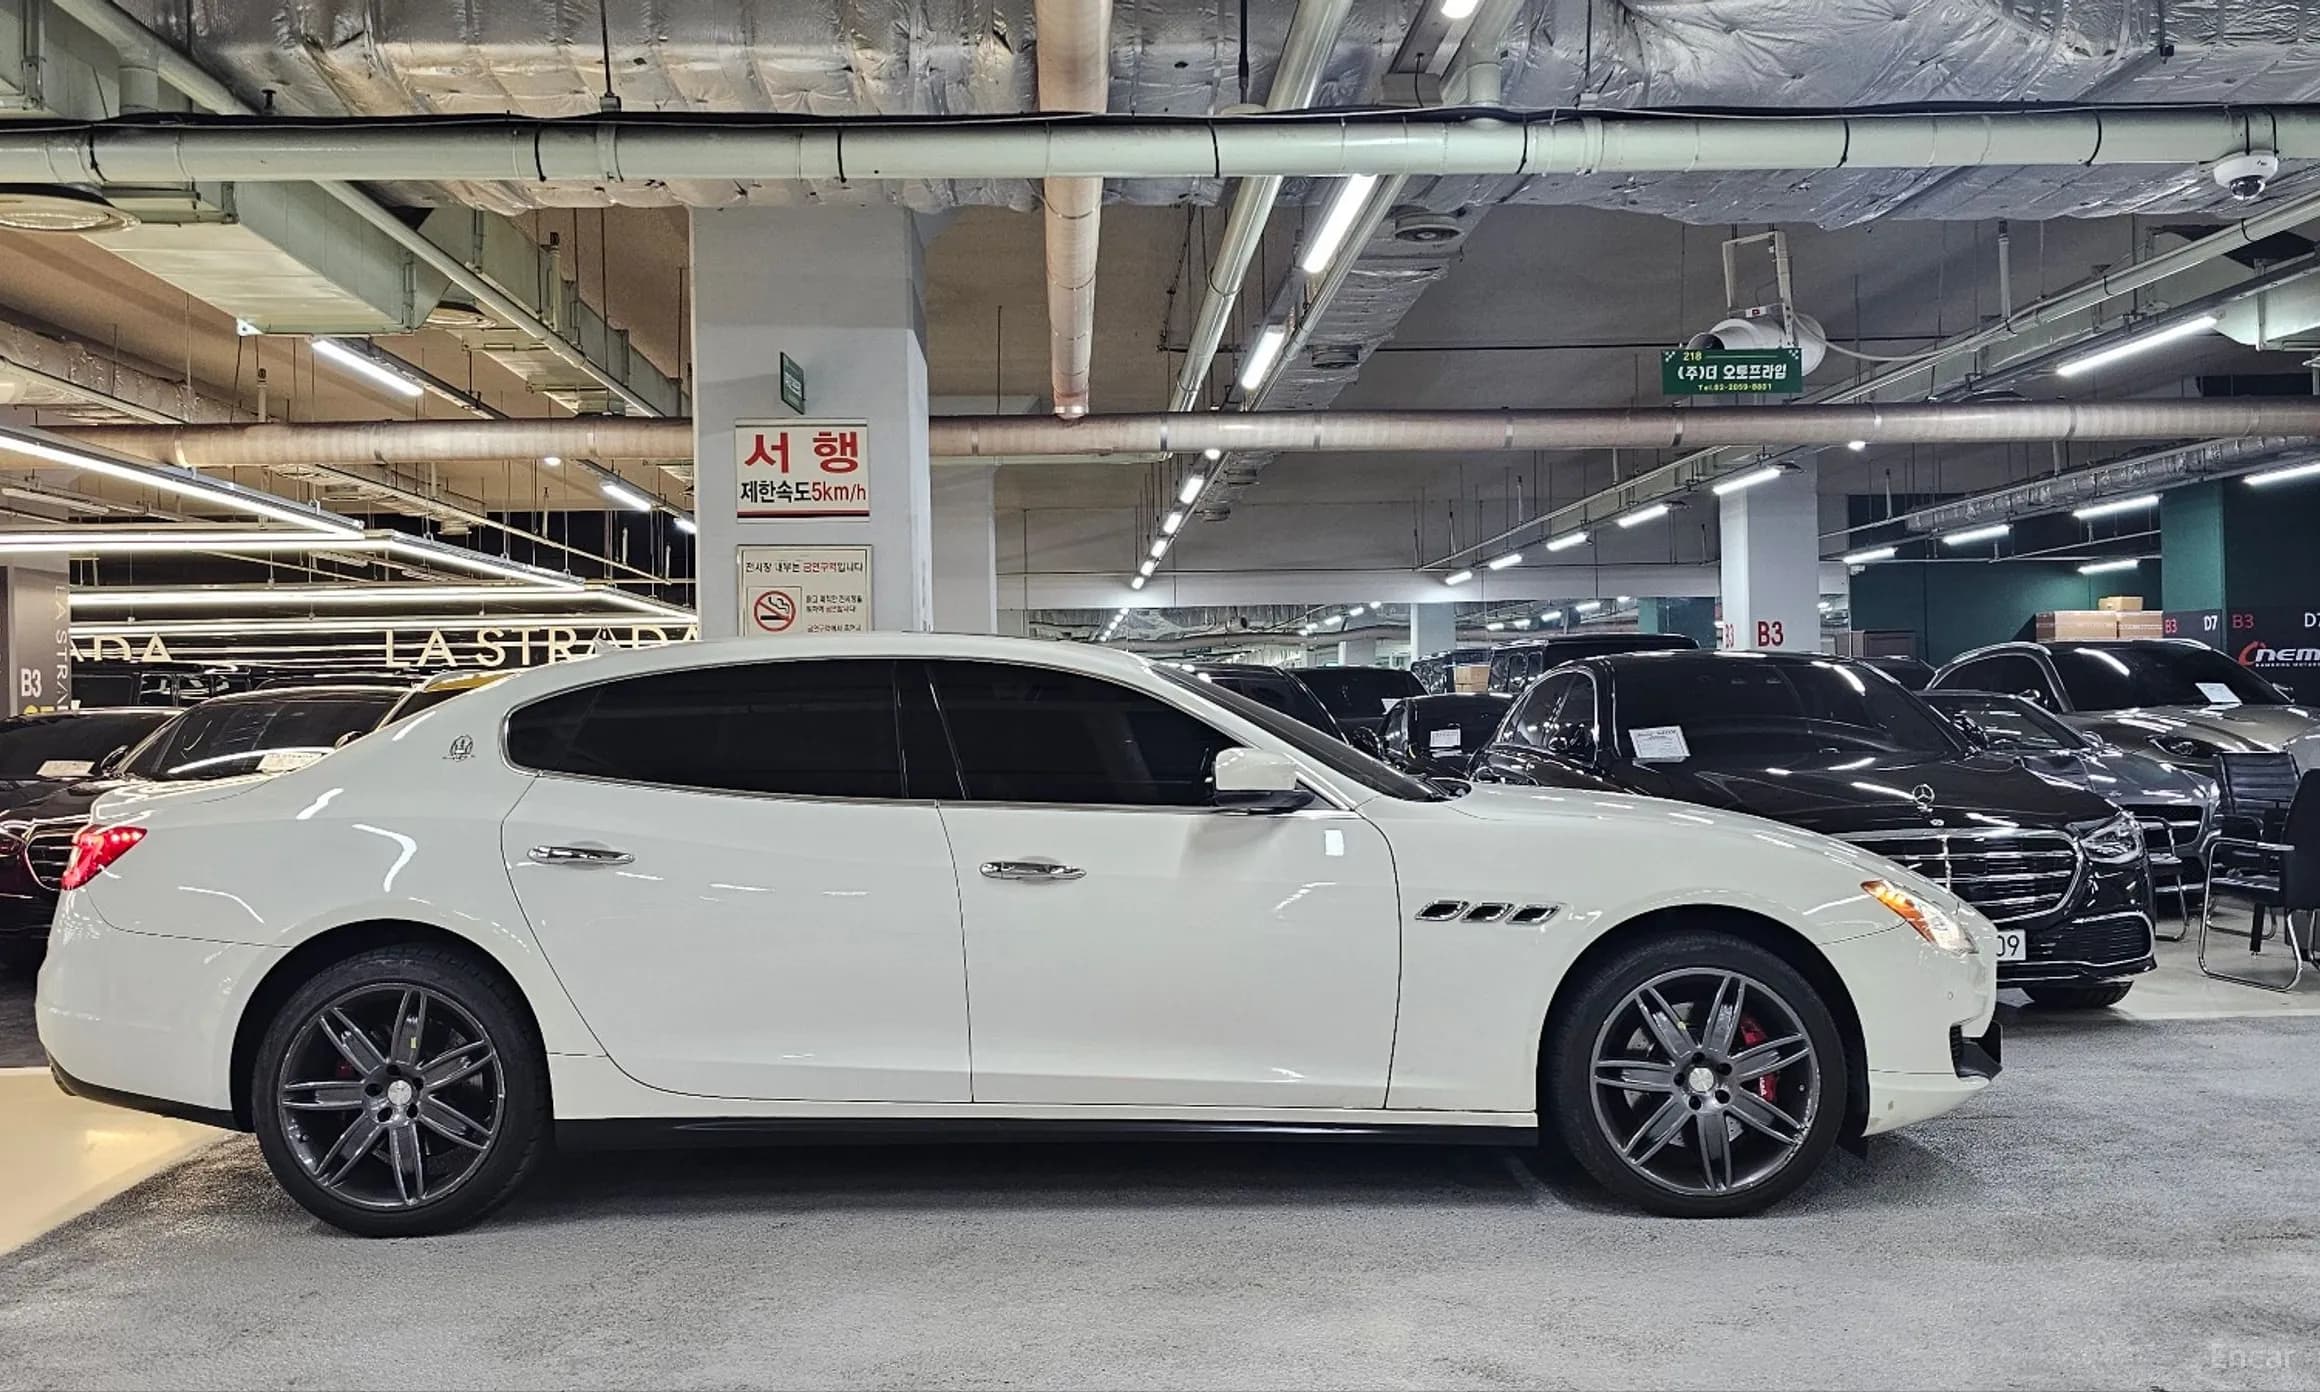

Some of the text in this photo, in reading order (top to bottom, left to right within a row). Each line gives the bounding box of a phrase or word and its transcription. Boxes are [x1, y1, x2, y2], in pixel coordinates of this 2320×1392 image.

[1682, 351, 1702, 361] 218
[1677, 363, 1787, 380] (주)더 오토프라임
[740, 480, 866, 503] 제한속도5km/h
[2165, 615, 2218, 634] B3 D7
[2231, 613, 2255, 629] B3
[1757, 621, 1784, 647] B3
[385, 626, 458, 668] LA
[55, 630, 69, 711] STRA
[20, 668, 42, 698] B3
